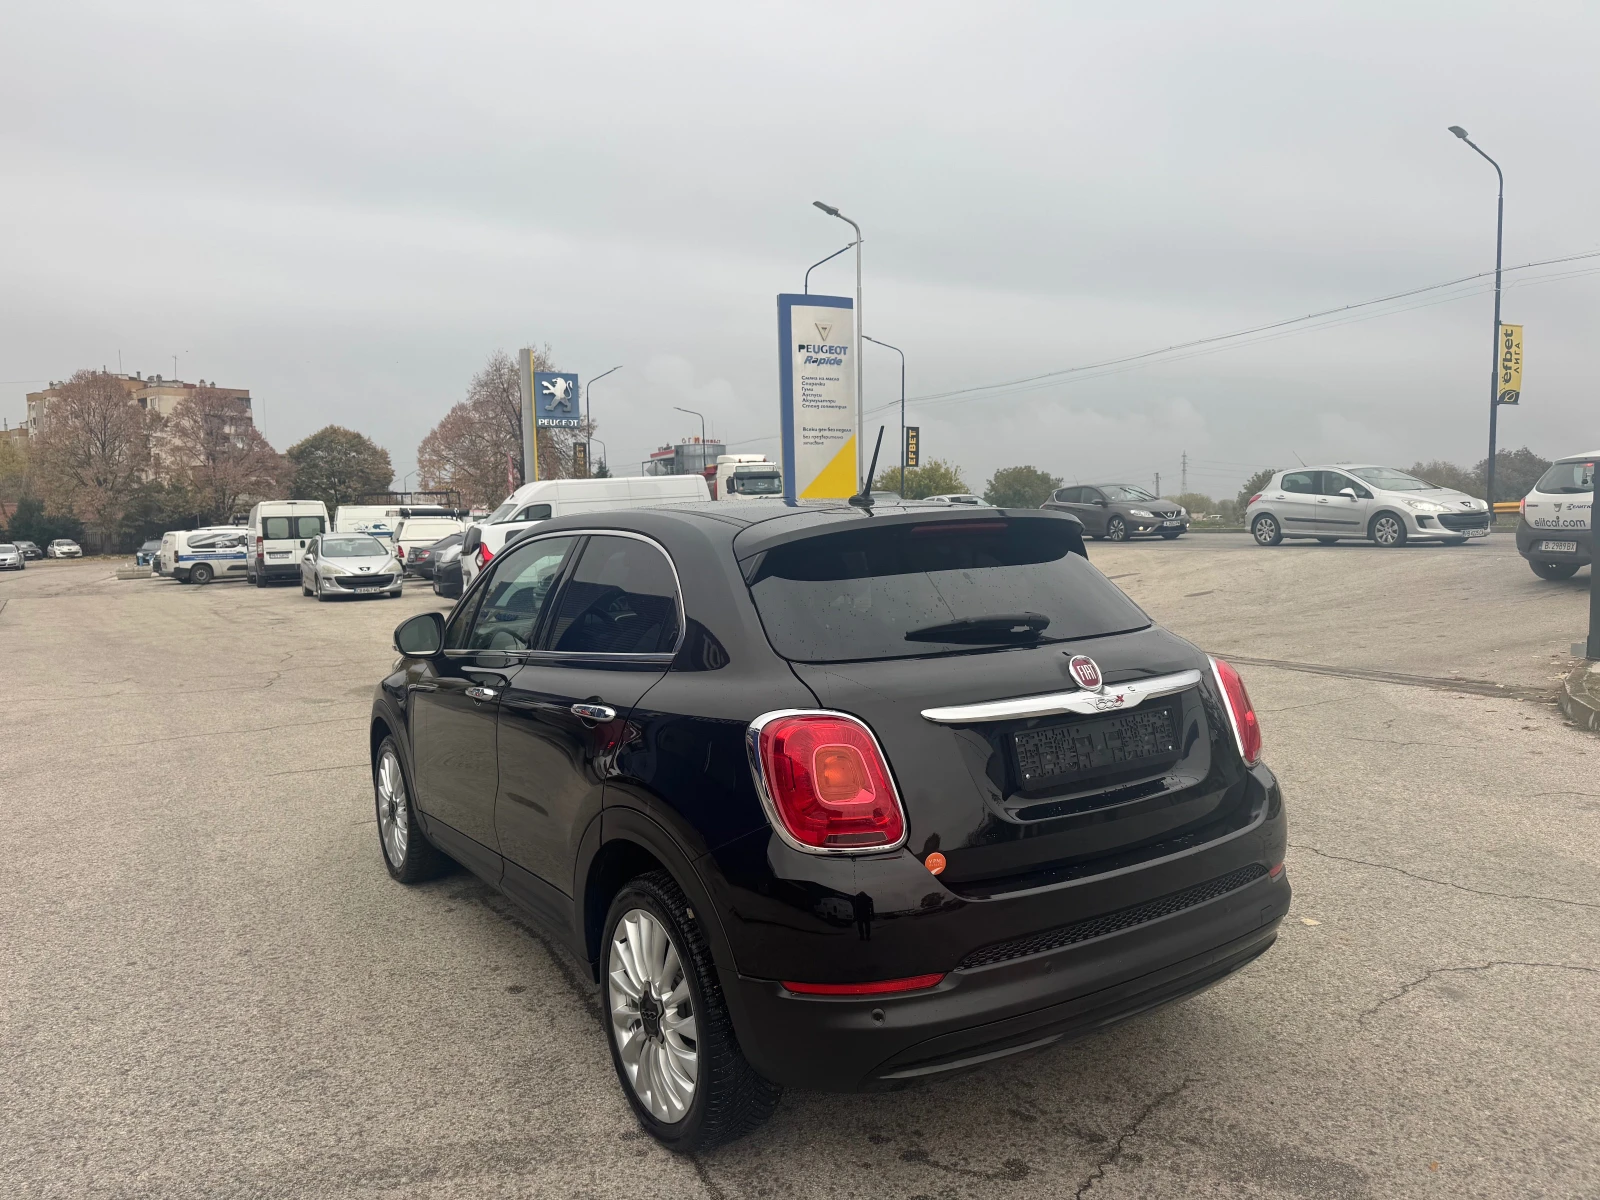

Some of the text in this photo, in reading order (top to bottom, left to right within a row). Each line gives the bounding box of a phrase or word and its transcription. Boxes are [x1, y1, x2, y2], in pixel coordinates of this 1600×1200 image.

[798, 344, 848, 355] PEUGEOT
[1503, 329, 1513, 383] efbet
[804, 355, 843, 366] Rapide
[908, 429, 916, 465] EFBET
[1076, 664, 1097, 680] FIAT
